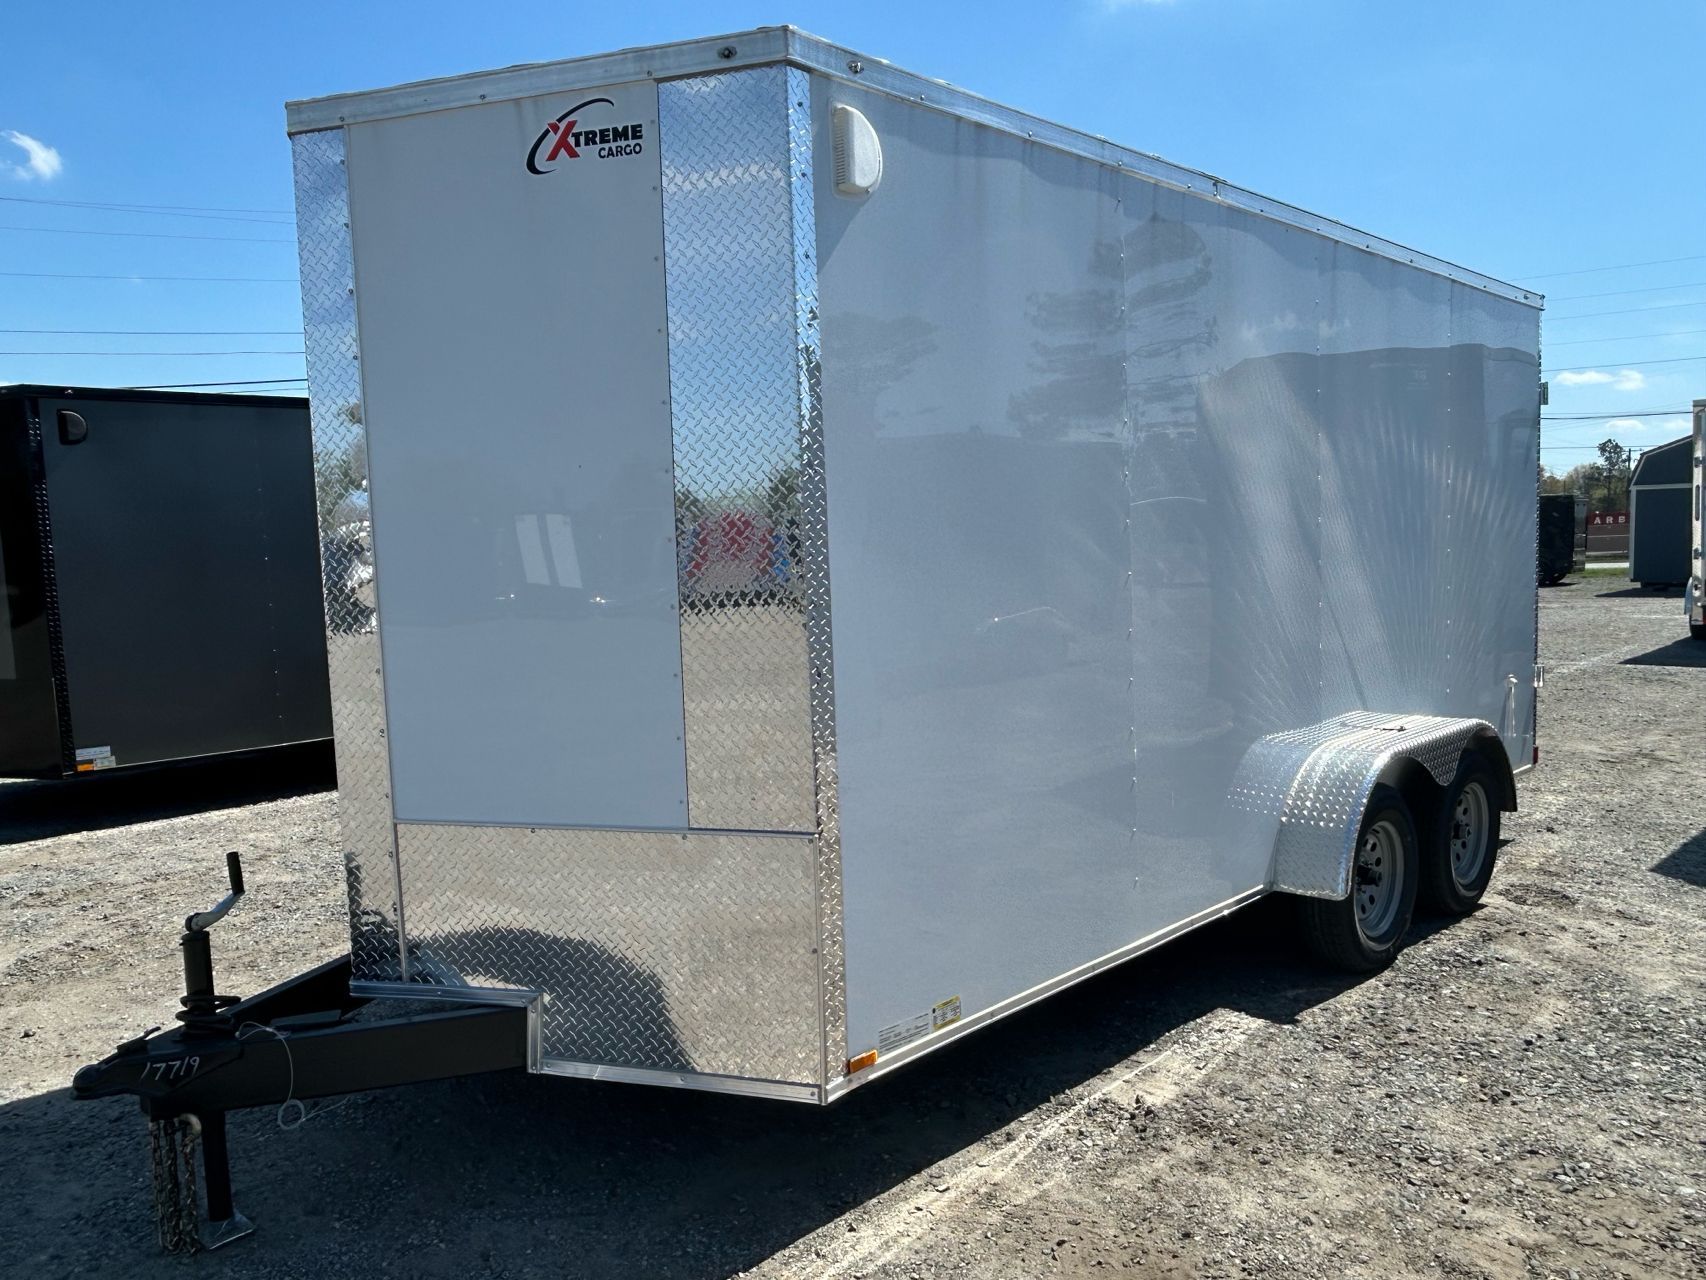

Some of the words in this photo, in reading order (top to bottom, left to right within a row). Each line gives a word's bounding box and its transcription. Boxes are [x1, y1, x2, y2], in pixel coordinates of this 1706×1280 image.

[545, 119, 643, 161] XTREME
[598, 143, 643, 159] CARGO
[140, 1055, 200, 1081] 17719
